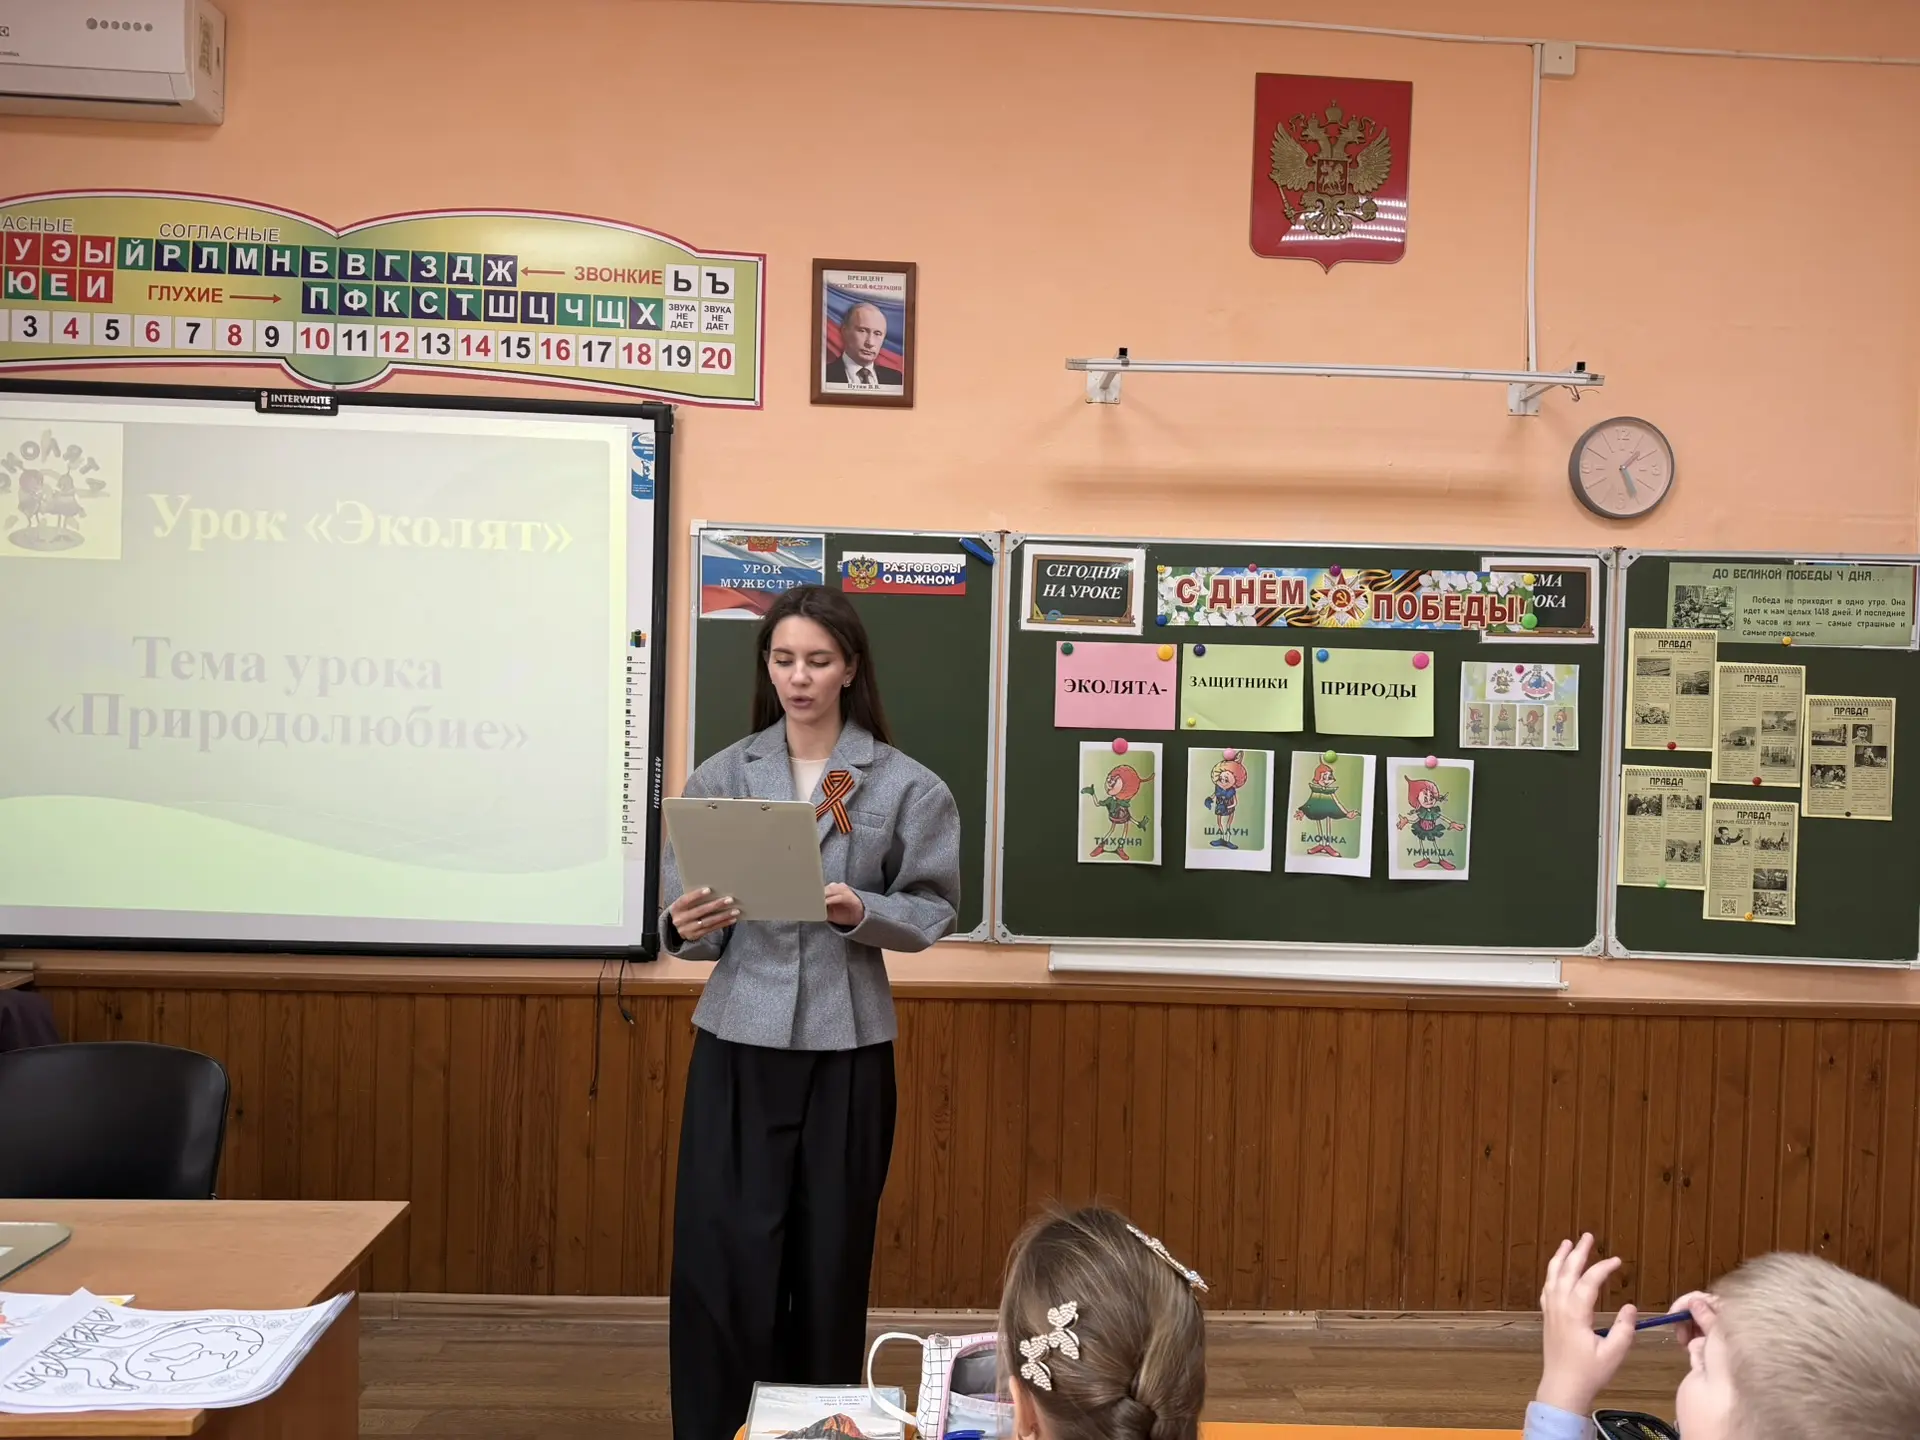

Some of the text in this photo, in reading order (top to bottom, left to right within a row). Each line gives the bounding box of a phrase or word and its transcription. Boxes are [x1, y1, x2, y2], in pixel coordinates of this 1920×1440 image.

[160, 223, 280, 242] СОГЛАСНЫЕ
[574, 266, 663, 284] ЗВОНКИЕ
[674, 270, 730, 294] Ь Ъ
[148, 285, 223, 303] ГЛУХИЕ
[668, 304, 696, 312] ЗВУКА
[704, 305, 732, 314] ЗВУКА
[676, 312, 688, 320] НЕ
[712, 314, 724, 322] НЕ
[670, 320, 694, 328] ДАЕТ
[706, 322, 729, 330] ДАЕТ
[23, 316, 732, 369] 3 4 5 6 7 8 9 10 11 12 13 14 15 16 17 18 19 20
[270, 394, 331, 404] INTERWRITE
[146, 493, 573, 552] Урок «Эколят»
[742, 564, 782, 575] УРОК
[882, 562, 961, 574] РАЗГОВОРЫ
[1046, 564, 1121, 580] СЕГОДНЯ
[883, 574, 955, 585] О ВАЖНОМ
[1712, 568, 1728, 580] ДО
[1733, 568, 1782, 580] ВЕЛИКОЙ
[1786, 569, 1832, 581] ПОБЕДЫ
[1042, 584, 1122, 600] НА УРОКЕ
[1176, 578, 1198, 604] С
[1209, 573, 1306, 610] ДНЁМ
[1533, 594, 1566, 608] ОКА
[1752, 596, 1780, 604] Победа
[1891, 598, 1906, 606] Она
[1373, 593, 1528, 627] ПОБЕДЫ!
[1788, 608, 1812, 616] целых
[1814, 608, 1830, 616] 1418
[1864, 610, 1906, 618] последние
[1658, 640, 1692, 649] ПРАВДА
[132, 636, 442, 698] Тема урока
[1188, 676, 1288, 690] ЗАЩИТНИКИ
[1744, 674, 1778, 684] ПРАВДА
[1064, 678, 1168, 696] ЭКОЛЯТА-
[1320, 681, 1417, 700] ПРИРОДЫ
[1834, 706, 1868, 716] ПРАВДА
[46, 692, 530, 752] «Природолюбие»
[1650, 777, 1684, 786] ПРАВДА
[1736, 811, 1771, 820] ПРАВДА
[1204, 826, 1249, 836] ШАЛУН
[1094, 836, 1142, 846] ТИХОНЯ
[1301, 831, 1346, 844] ЁЛОЧКА
[1406, 847, 1454, 857] УМНИЦА
